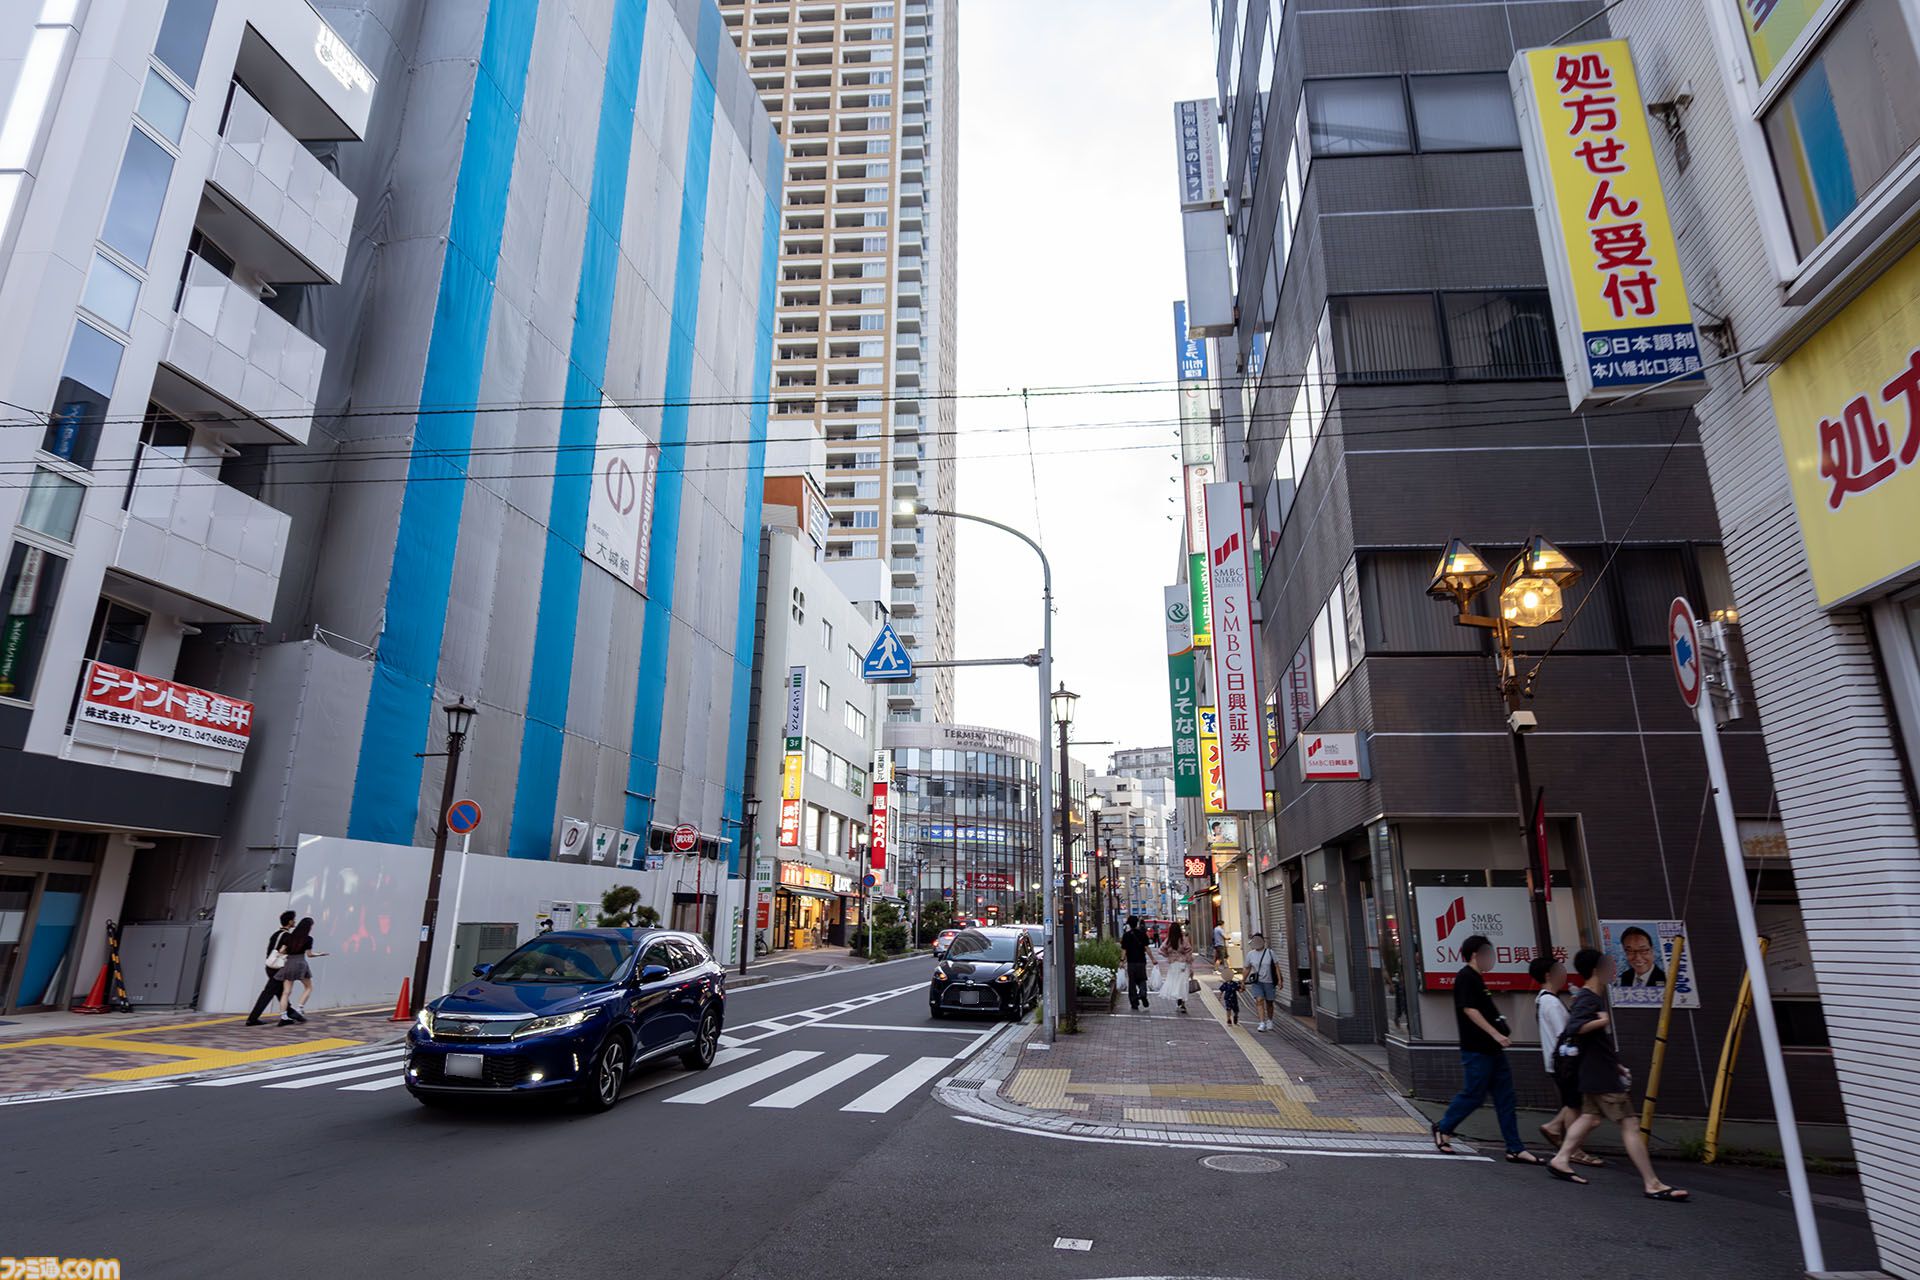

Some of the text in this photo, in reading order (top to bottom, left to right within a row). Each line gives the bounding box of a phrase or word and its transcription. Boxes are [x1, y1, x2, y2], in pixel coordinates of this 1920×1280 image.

[1183, 103, 1202, 200] 個別教室のトライ
[1556, 54, 1657, 318] 処方せん受付
[1612, 331, 1696, 354] 日本調剤
[1592, 355, 1700, 379] 本八幡北口薬局
[1214, 567, 1243, 577] SMBC
[1215, 576, 1244, 584] NIKKO
[1222, 595, 1251, 752] SMBC日興証券
[92, 669, 250, 730] テナント募集中
[791, 690, 800, 731] いいオフィス
[85, 705, 176, 734] 株式会社アービック
[1174, 677, 1197, 776] りそな銀行
[789, 739, 800, 747] 3F
[873, 815, 886, 848] KFC
[1471, 913, 1502, 923] SMBC
[1473, 923, 1504, 931] NIKKO
